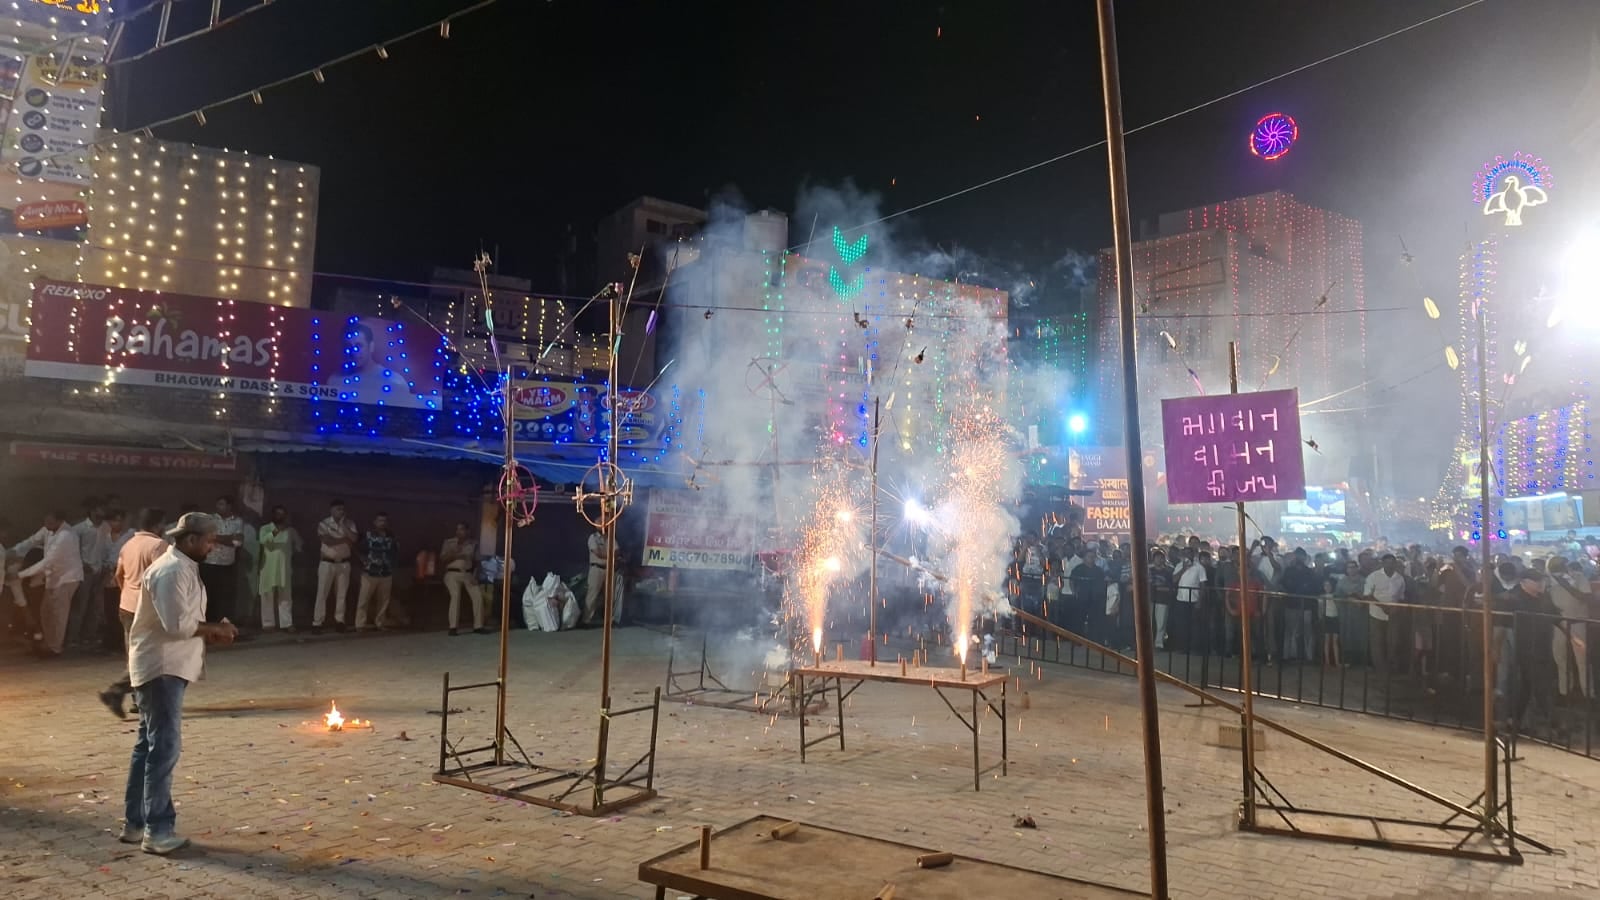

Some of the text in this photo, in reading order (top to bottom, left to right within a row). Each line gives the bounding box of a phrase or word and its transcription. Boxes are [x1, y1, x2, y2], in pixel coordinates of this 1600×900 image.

[42, 285, 105, 300] RELAXO
[105, 315, 270, 366] Bahamas
[155, 373, 338, 398] BHAGWAN DASS & SONS
[1087, 507, 1130, 519] FASHIO
[1096, 519, 1131, 529] BAZAA
[649, 550, 664, 561] M.
